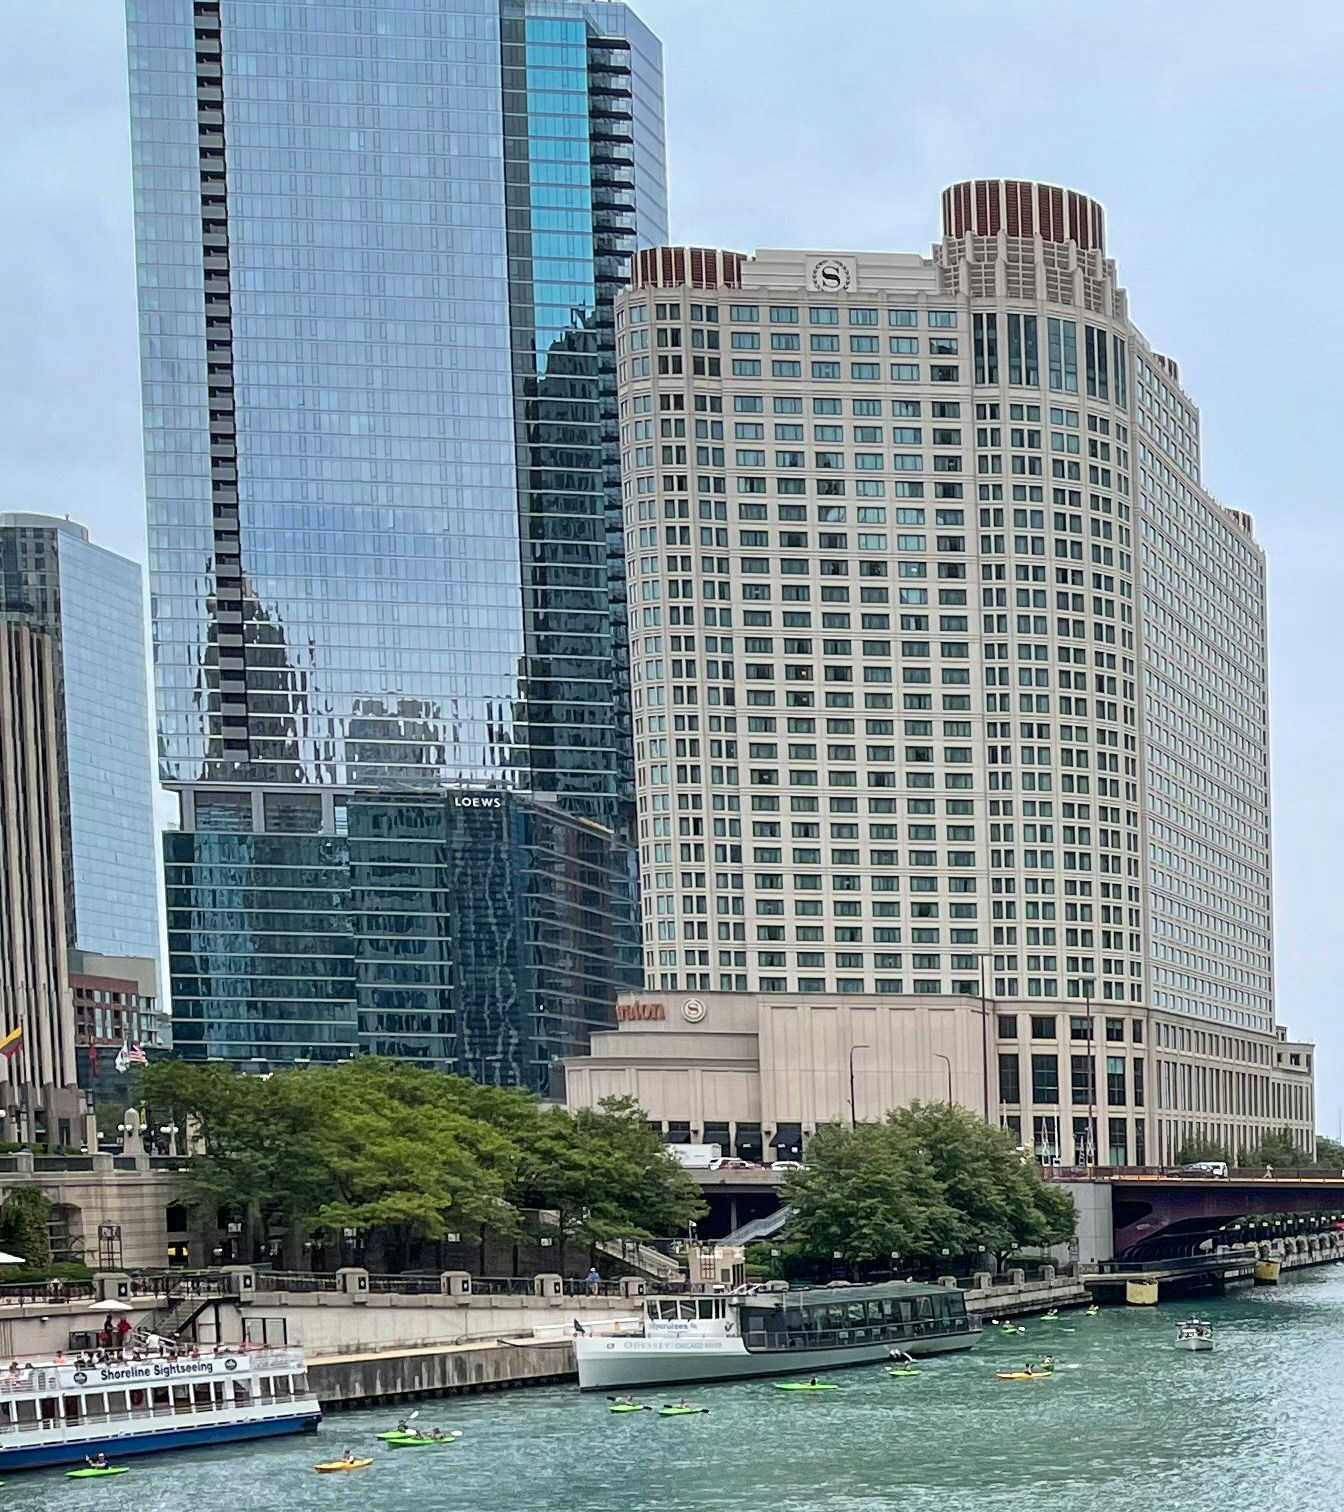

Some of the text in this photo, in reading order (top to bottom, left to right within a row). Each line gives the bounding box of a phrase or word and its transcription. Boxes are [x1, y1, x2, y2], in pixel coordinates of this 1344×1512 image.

[455, 797, 501, 808] LOEWS
[100, 1360, 213, 1381] Shoreline Sightseeing
